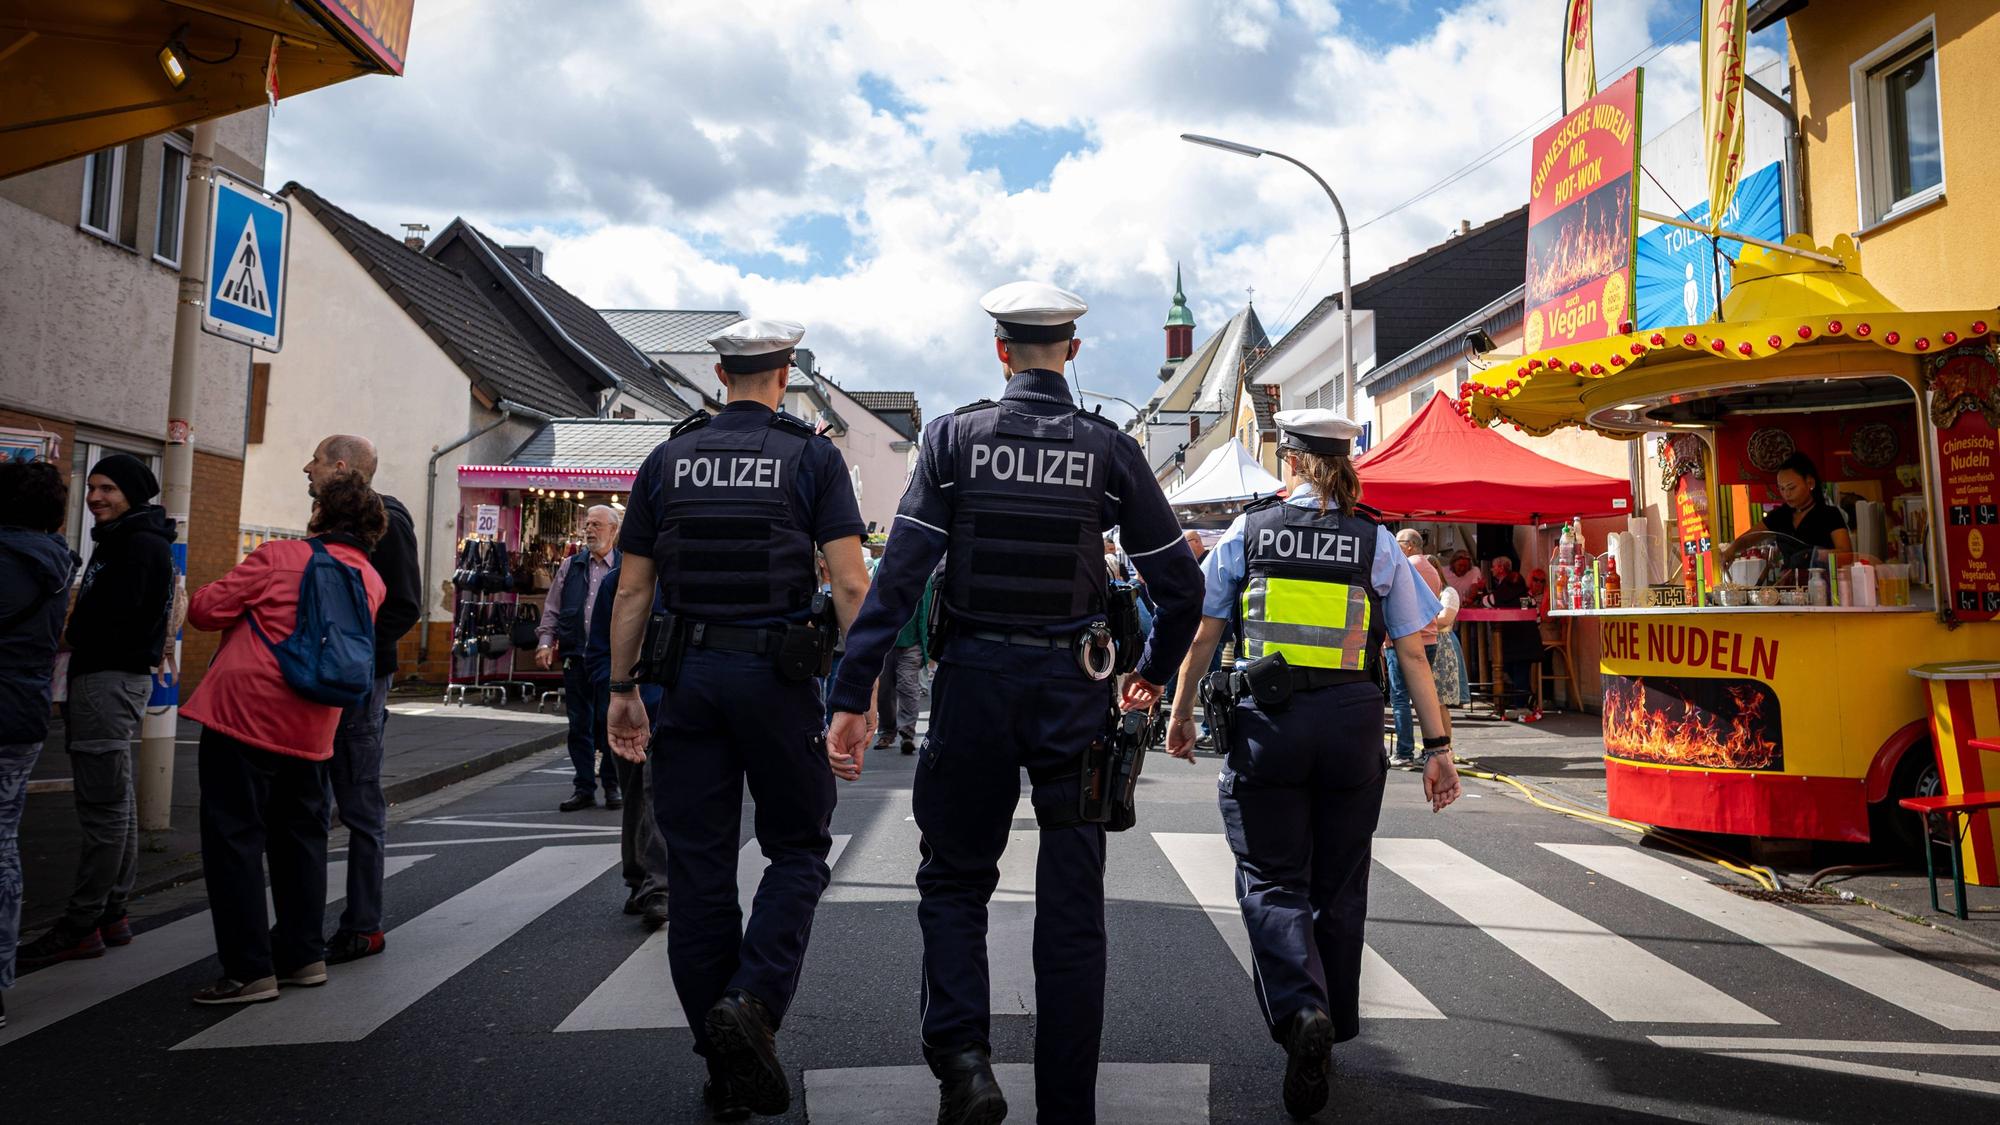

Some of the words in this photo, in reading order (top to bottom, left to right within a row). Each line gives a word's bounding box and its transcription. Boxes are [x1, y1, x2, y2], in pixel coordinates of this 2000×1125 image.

[1532, 107, 1592, 199] CHINESISCHE
[1591, 103, 1633, 147] NUDELN
[1568, 139, 1588, 170] MR.
[1554, 156, 1602, 206] HOT-WOK
[1565, 292, 1580, 309] auch
[1548, 299, 1597, 340] Vegan
[1943, 434, 1995, 456] Chinesische
[674, 457, 782, 488] POLIZEI
[970, 444, 1095, 488] POLIZEI
[1950, 450, 1990, 472] Nudeln
[526, 475, 559, 487] TOP
[568, 476, 622, 489] TREND
[1257, 528, 1360, 564] POLIZEI
[1961, 570, 1996, 582] Vegetarisch
[1967, 559, 1987, 572] Vegan
[1647, 623, 1779, 681] NUDELN
